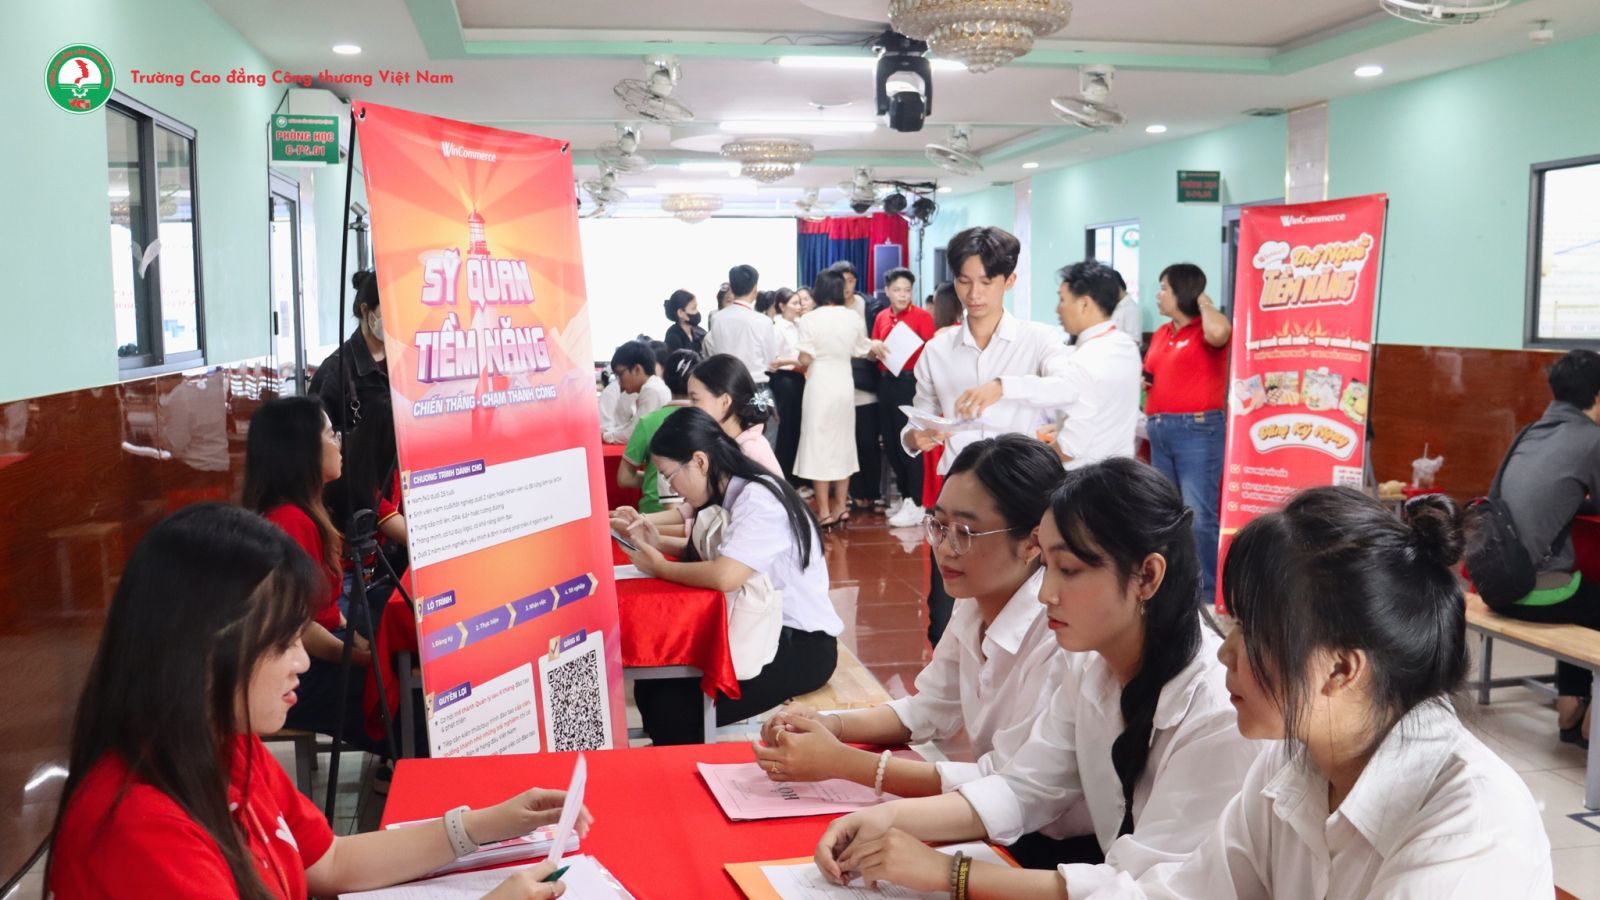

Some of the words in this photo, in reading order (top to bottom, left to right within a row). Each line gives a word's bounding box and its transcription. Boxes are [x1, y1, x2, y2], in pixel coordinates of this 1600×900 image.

[441, 141, 497, 163] WinCommerce
[1280, 213, 1346, 227] WinCommerce
[421, 248, 462, 306] SỸ
[466, 258, 536, 310] QUAN
[1262, 265, 1305, 308] TIỀM
[1302, 266, 1357, 304] NĂNG
[415, 311, 481, 383] TIỀM
[483, 316, 551, 376] NĂNG
[413, 395, 443, 417] CHIẾN
[445, 391, 476, 412] THẮNG
[481, 391, 507, 408] CHẠM
[507, 386, 534, 402] THÀNH
[535, 384, 557, 399] CÔNG
